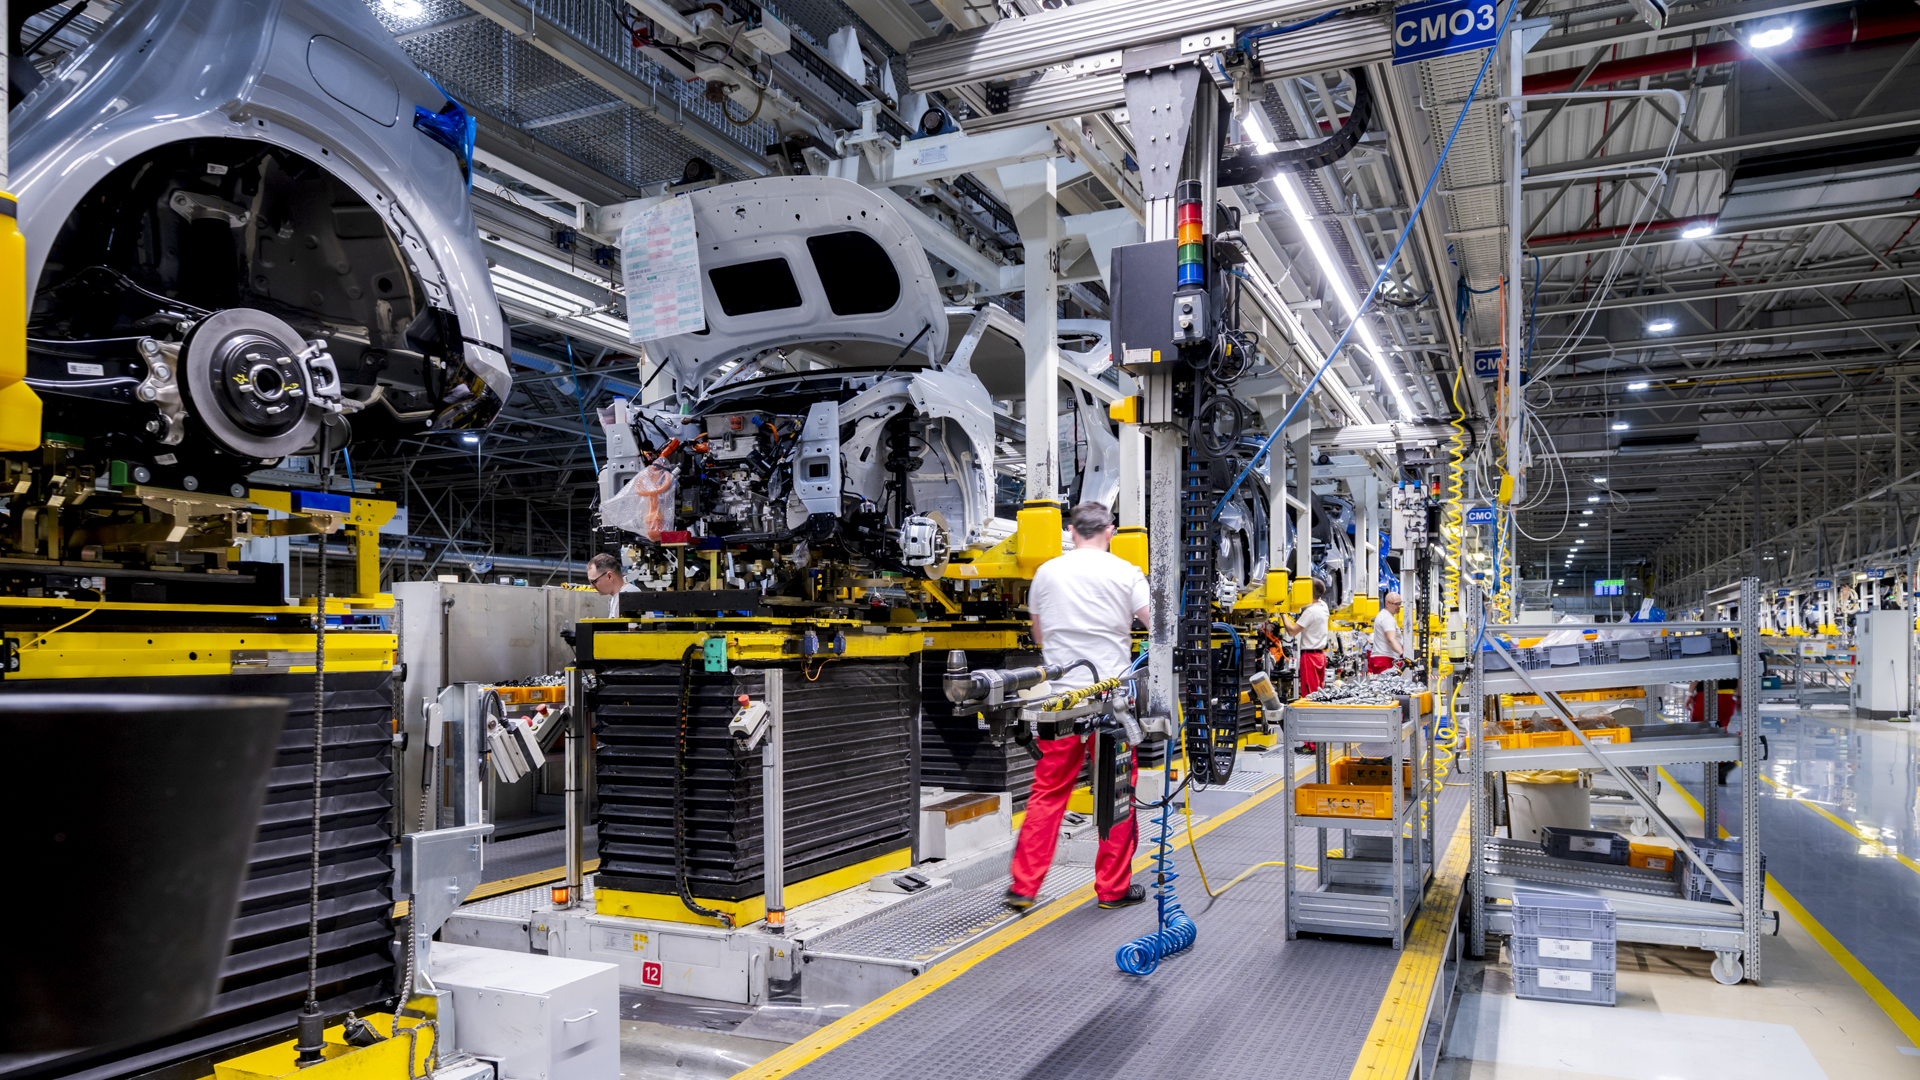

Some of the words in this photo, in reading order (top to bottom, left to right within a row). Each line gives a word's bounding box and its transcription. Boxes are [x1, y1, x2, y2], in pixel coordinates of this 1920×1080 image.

[1396, 4, 1495, 47] CMO3
[1468, 511, 1492, 520] CMO
[645, 966, 658, 981] 12
